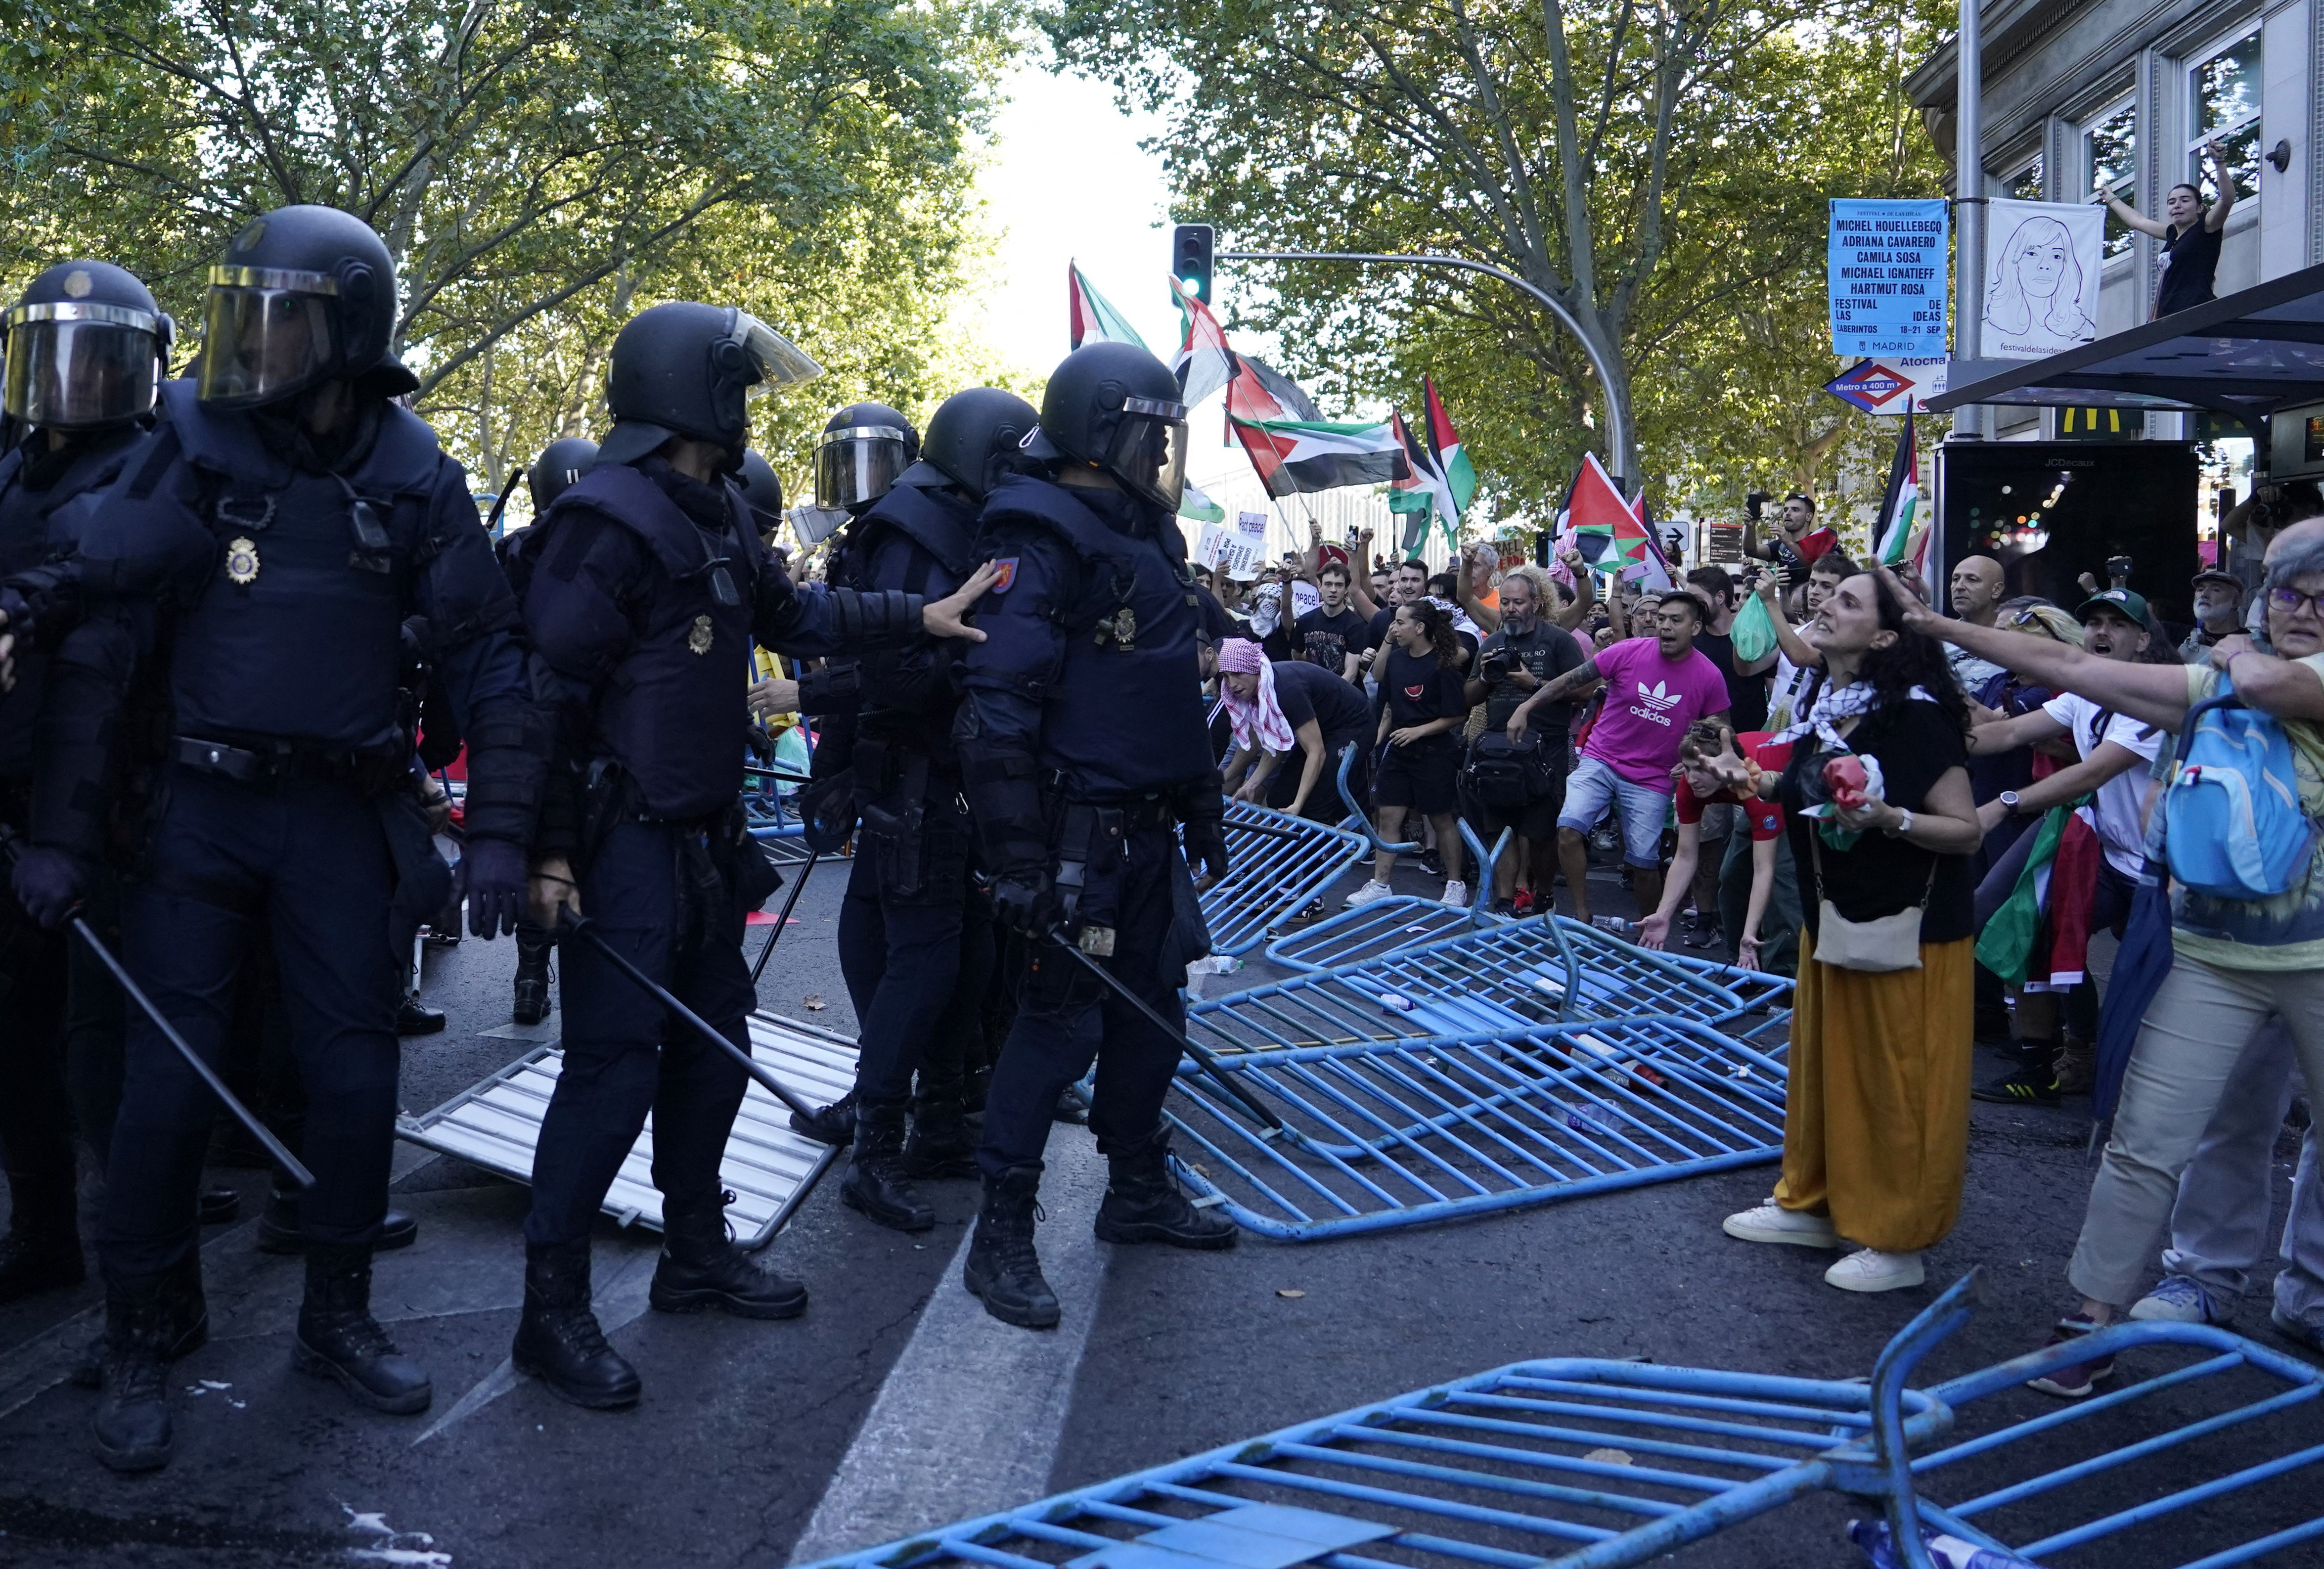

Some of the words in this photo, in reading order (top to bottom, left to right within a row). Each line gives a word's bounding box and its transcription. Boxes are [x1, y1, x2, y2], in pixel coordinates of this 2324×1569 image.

[1836, 220, 1872, 231] MICHEL
[1876, 221, 1942, 234] HOUELLEBECQ
[1842, 236, 1884, 247] ADRIANA
[1887, 236, 1935, 248] CAVARERO
[1857, 252, 1892, 263] CAMILA
[1896, 252, 1921, 263] SOSA
[1841, 267, 1884, 278] MICHAEL
[1888, 268, 1935, 279] IGNATIEFF
[1851, 283, 1898, 294] HARTMUT
[1901, 284, 1924, 295] ROSA
[1835, 299, 1877, 309] FESTIVAL
[1929, 300, 1941, 310] DE
[1835, 310, 1851, 320] LAS
[1913, 311, 1941, 321] IDEAS
[1836, 324, 1877, 333] LABERINTOS
[1873, 342, 1915, 351] MADRID
[2045, 458, 2095, 467] JCDecaux
[1630, 705, 1671, 727] adidas
